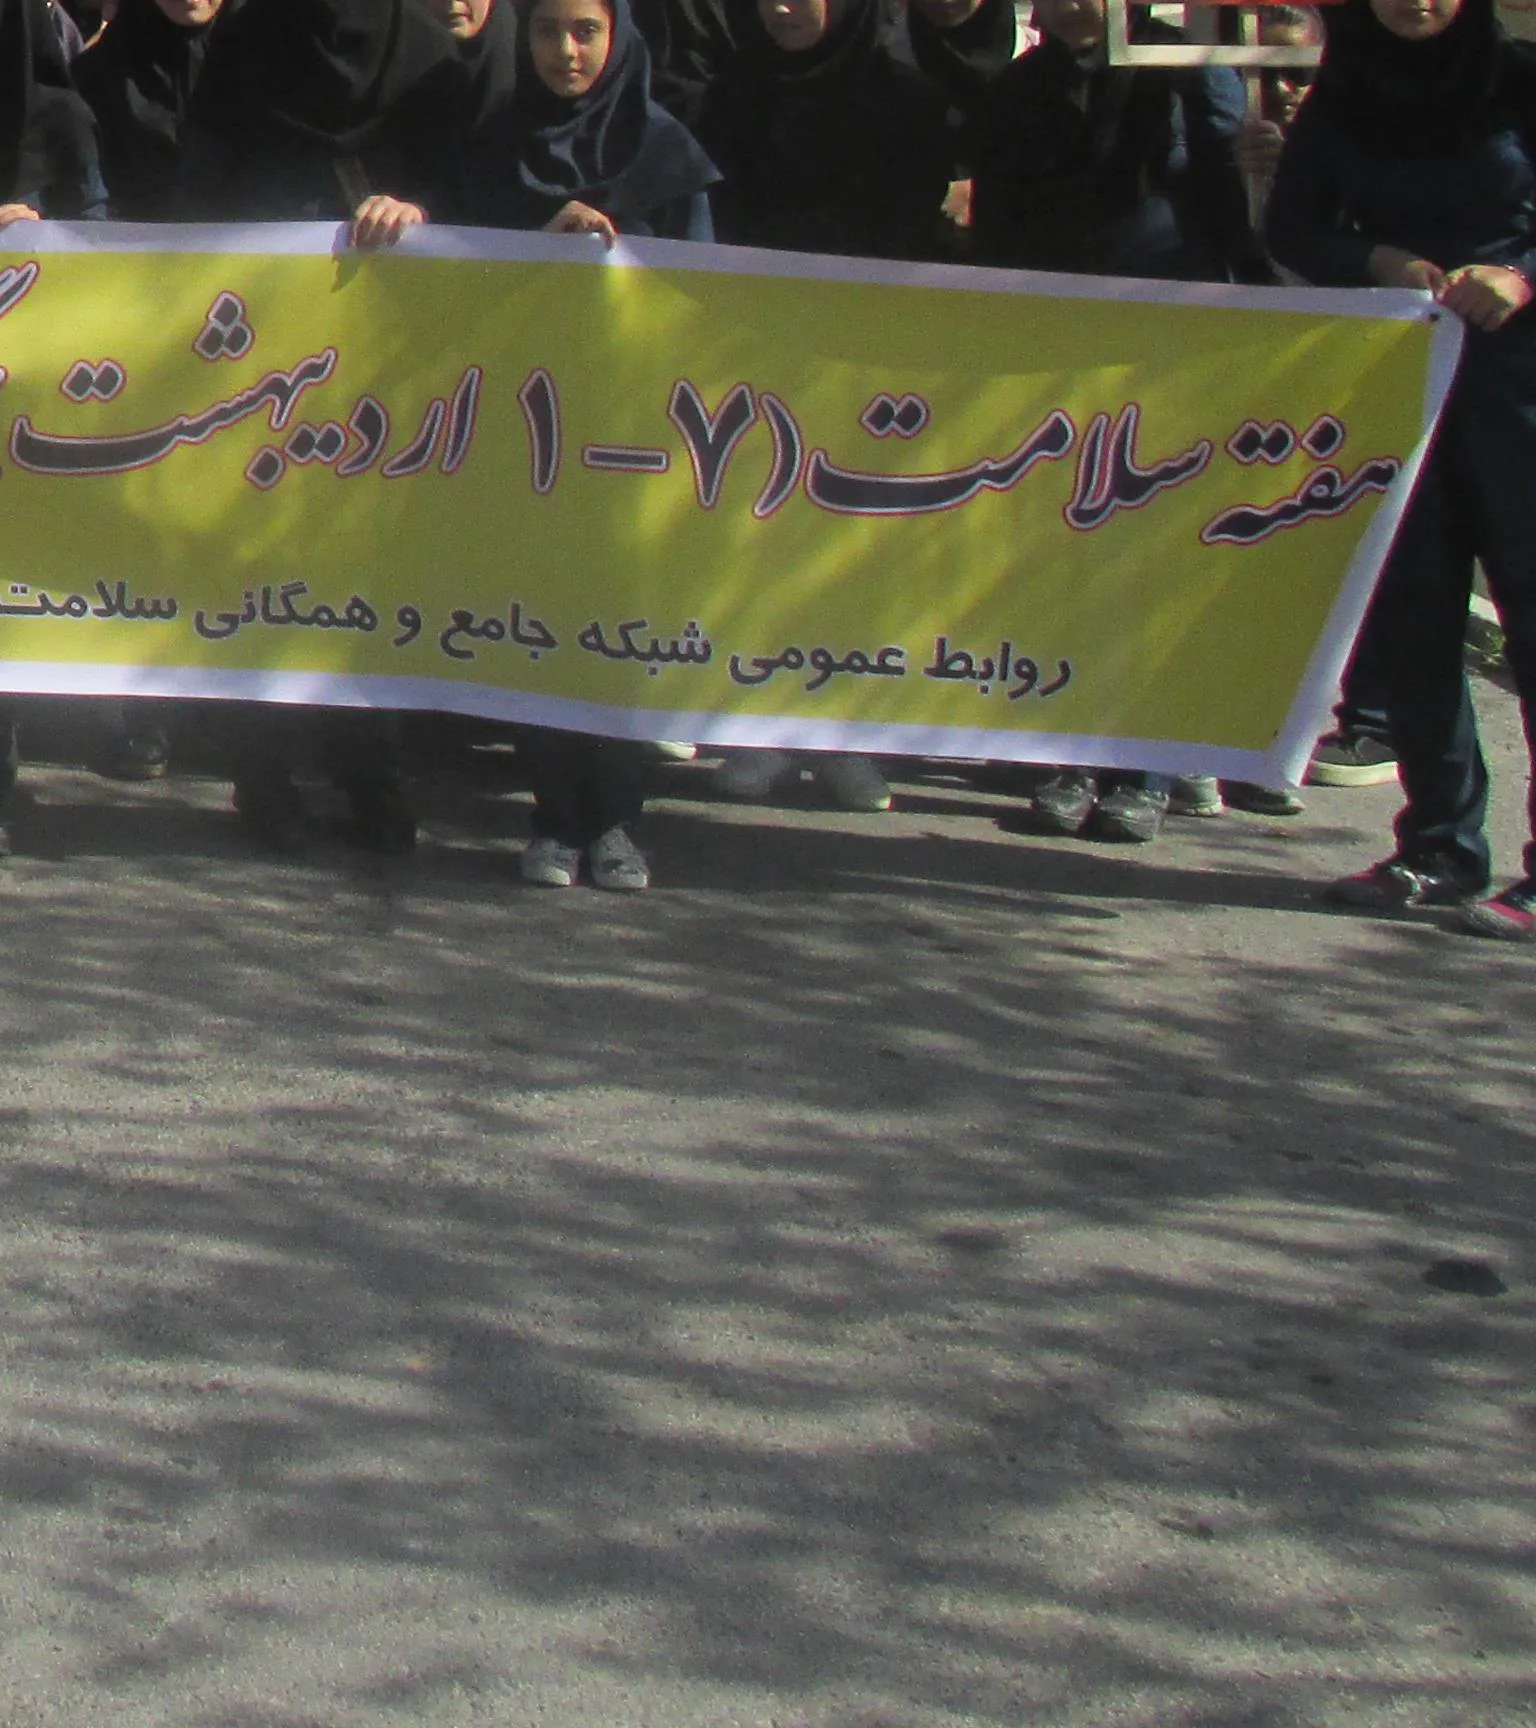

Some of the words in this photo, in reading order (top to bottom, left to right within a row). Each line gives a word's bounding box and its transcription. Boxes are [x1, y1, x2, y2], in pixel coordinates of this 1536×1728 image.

[1200, 414, 1405, 547] هفته
[193, 580, 380, 640] همگانی
[392, 603, 423, 646] و
[439, 601, 560, 660] جامع
[577, 618, 714, 677] شبکه
[728, 643, 907, 692] عمومی
[923, 634, 1072, 701] روابط
